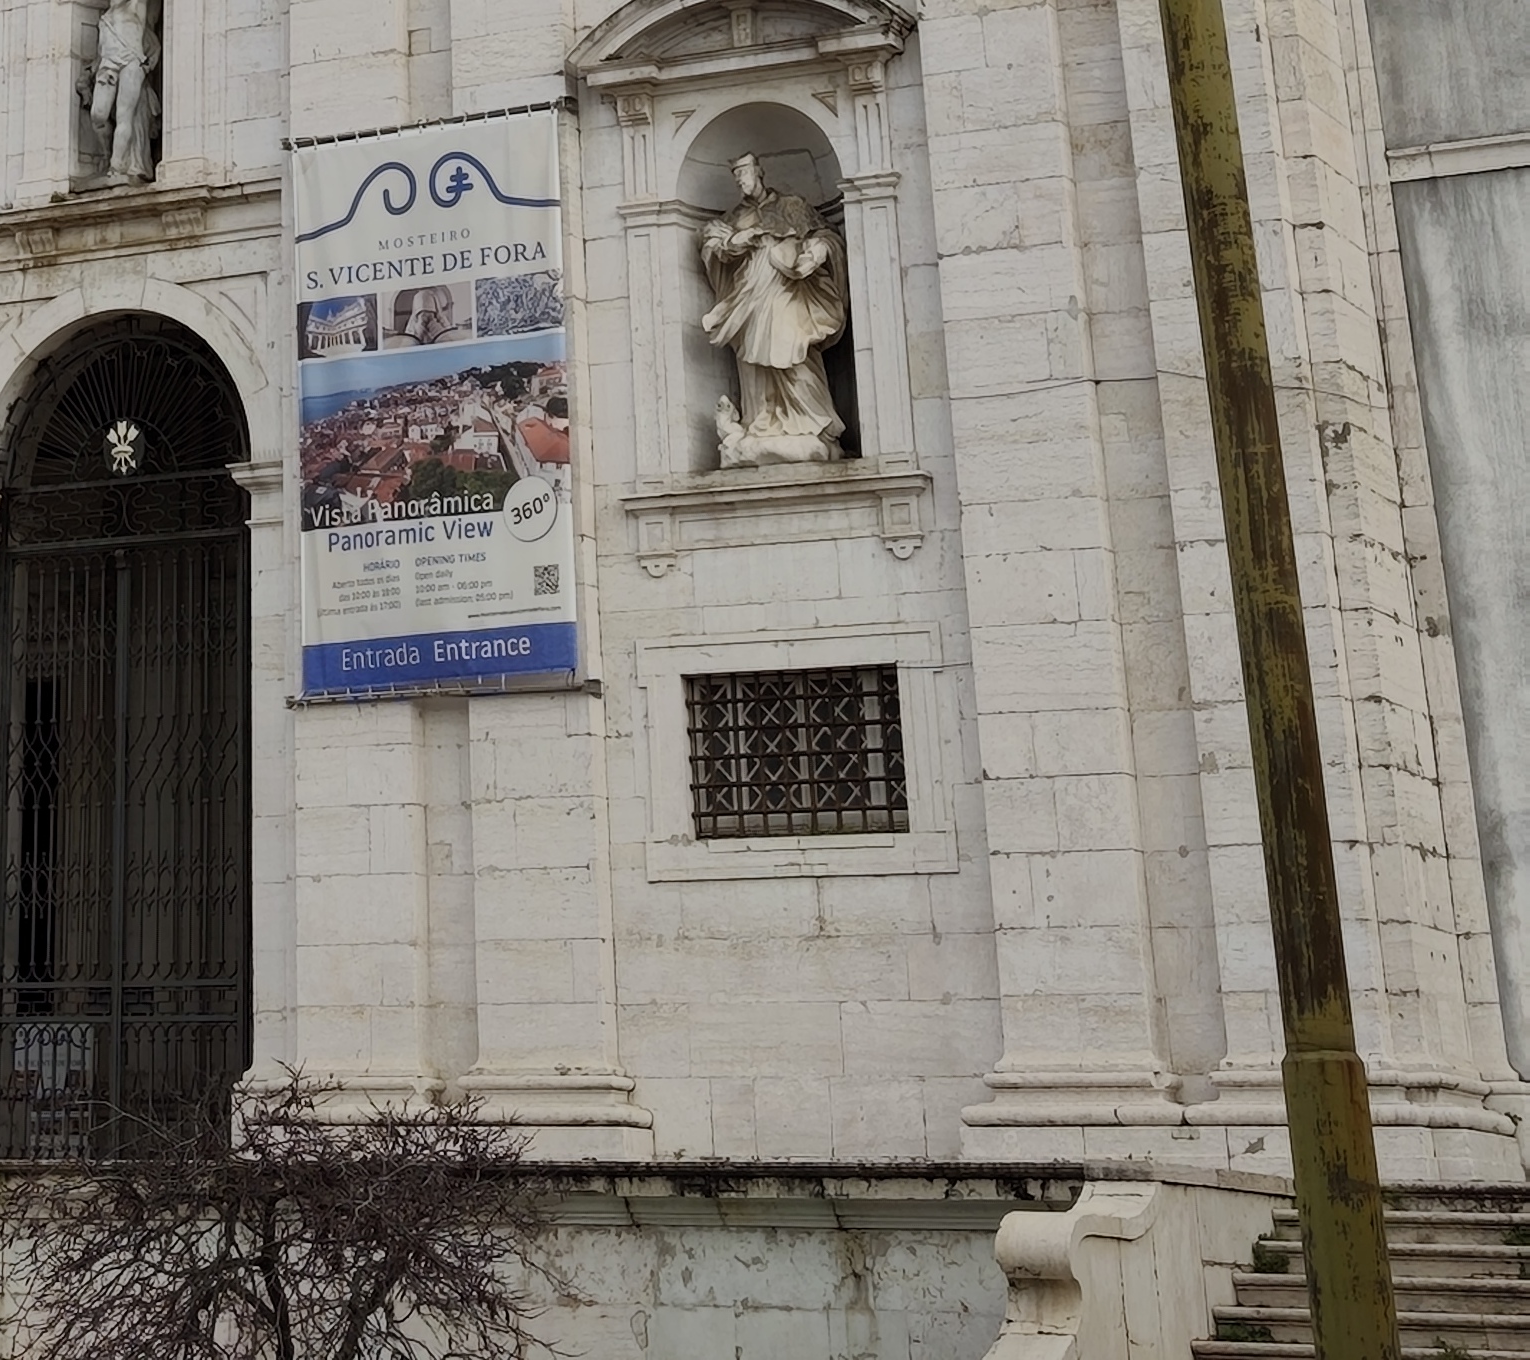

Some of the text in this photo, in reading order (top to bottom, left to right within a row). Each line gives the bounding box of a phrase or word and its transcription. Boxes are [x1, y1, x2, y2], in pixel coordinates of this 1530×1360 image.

[378, 228, 471, 252] MOSTEIRO
[306, 241, 547, 290] S. VICENTE DE FORA
[310, 491, 495, 528] Vista Panorâmica
[328, 519, 494, 553] Panoramic View
[415, 552, 487, 568] OPENING TIMES
[342, 635, 532, 671] Entrada Entrance
